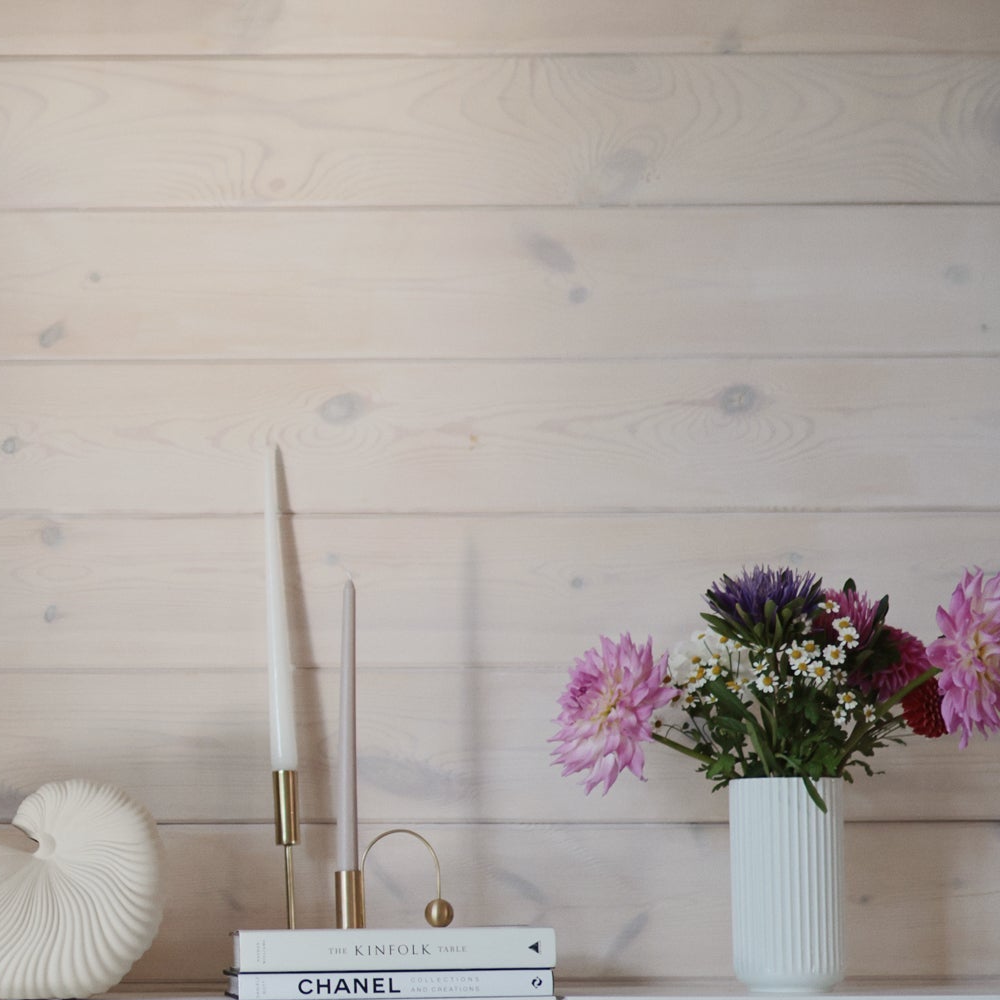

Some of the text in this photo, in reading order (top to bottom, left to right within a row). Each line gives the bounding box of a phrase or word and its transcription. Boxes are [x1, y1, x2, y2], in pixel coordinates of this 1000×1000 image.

[328, 944, 468, 956] THE KINFOLK TABLE
[297, 977, 401, 995] CHANEL
